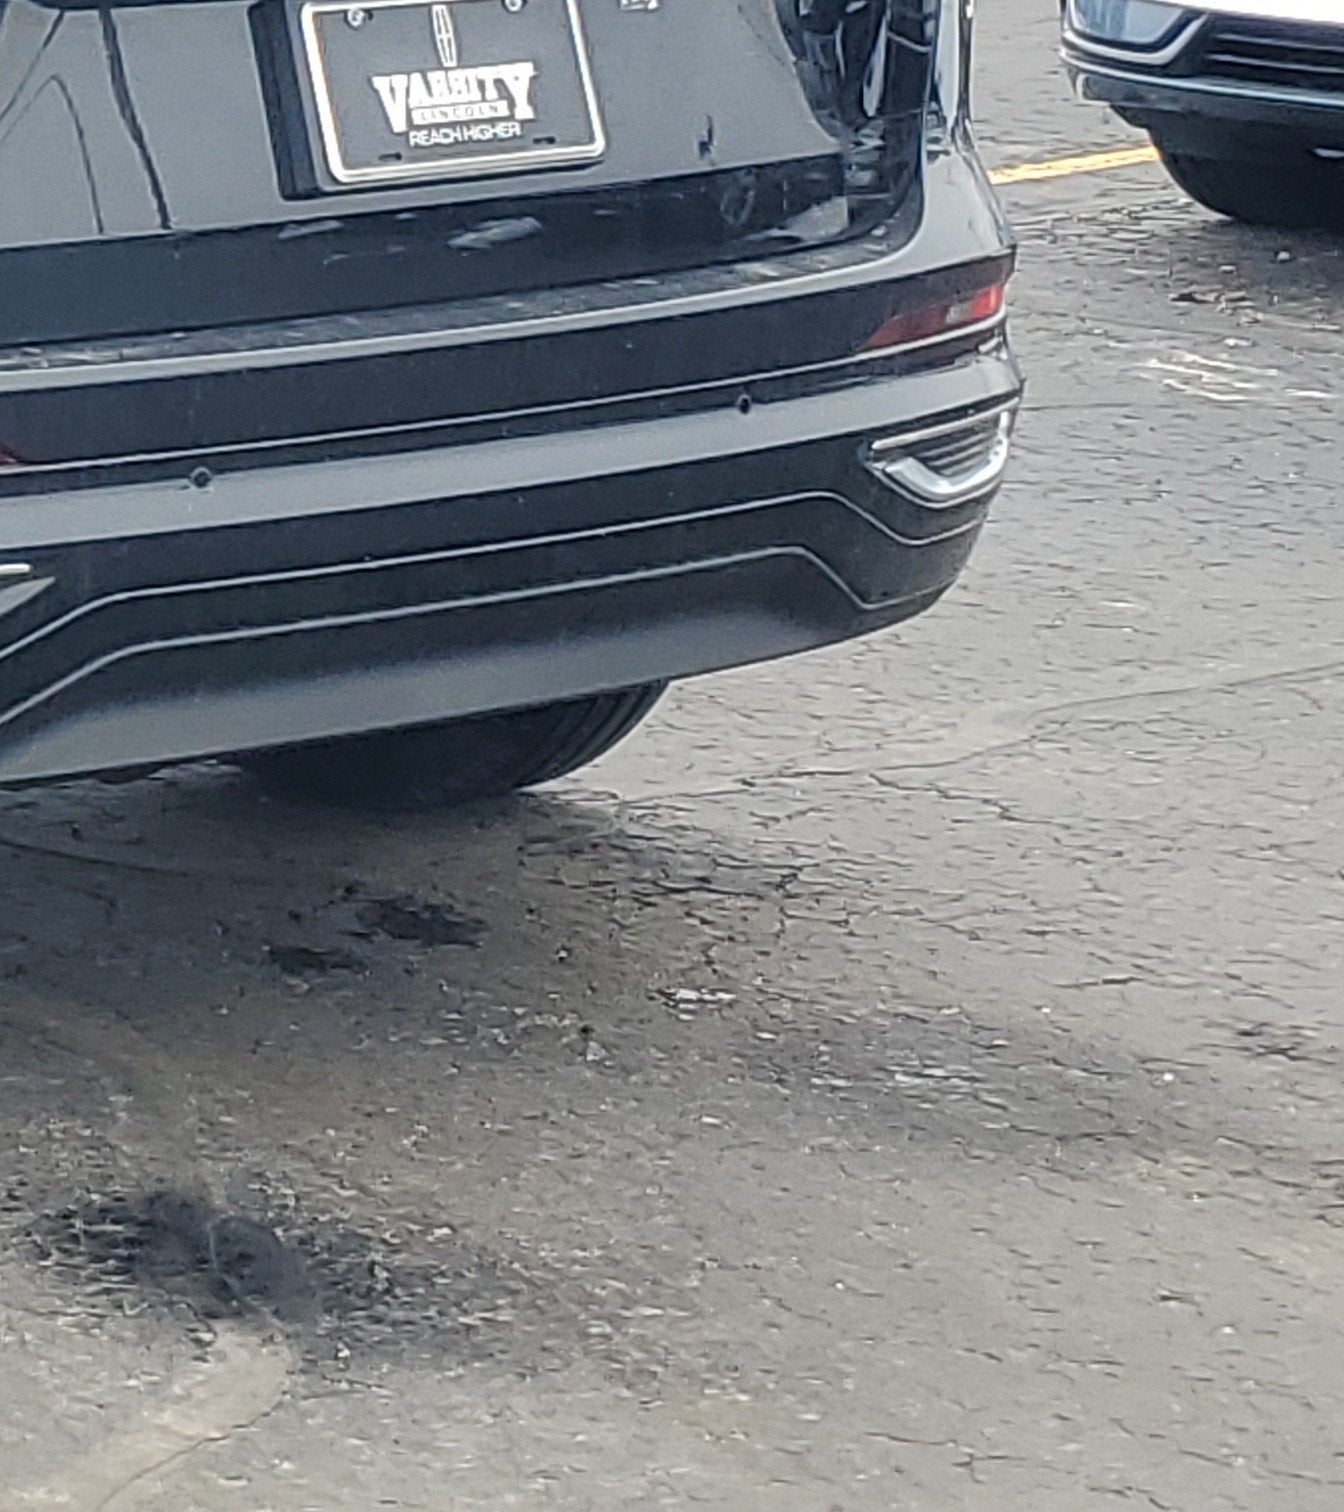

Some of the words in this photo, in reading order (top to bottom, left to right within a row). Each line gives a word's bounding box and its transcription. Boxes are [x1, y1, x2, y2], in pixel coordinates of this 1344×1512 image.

[372, 61, 537, 134] VARSITY
[420, 104, 500, 122] LINCOLN
[409, 124, 462, 148] REACH
[463, 121, 523, 143] HIGHER
